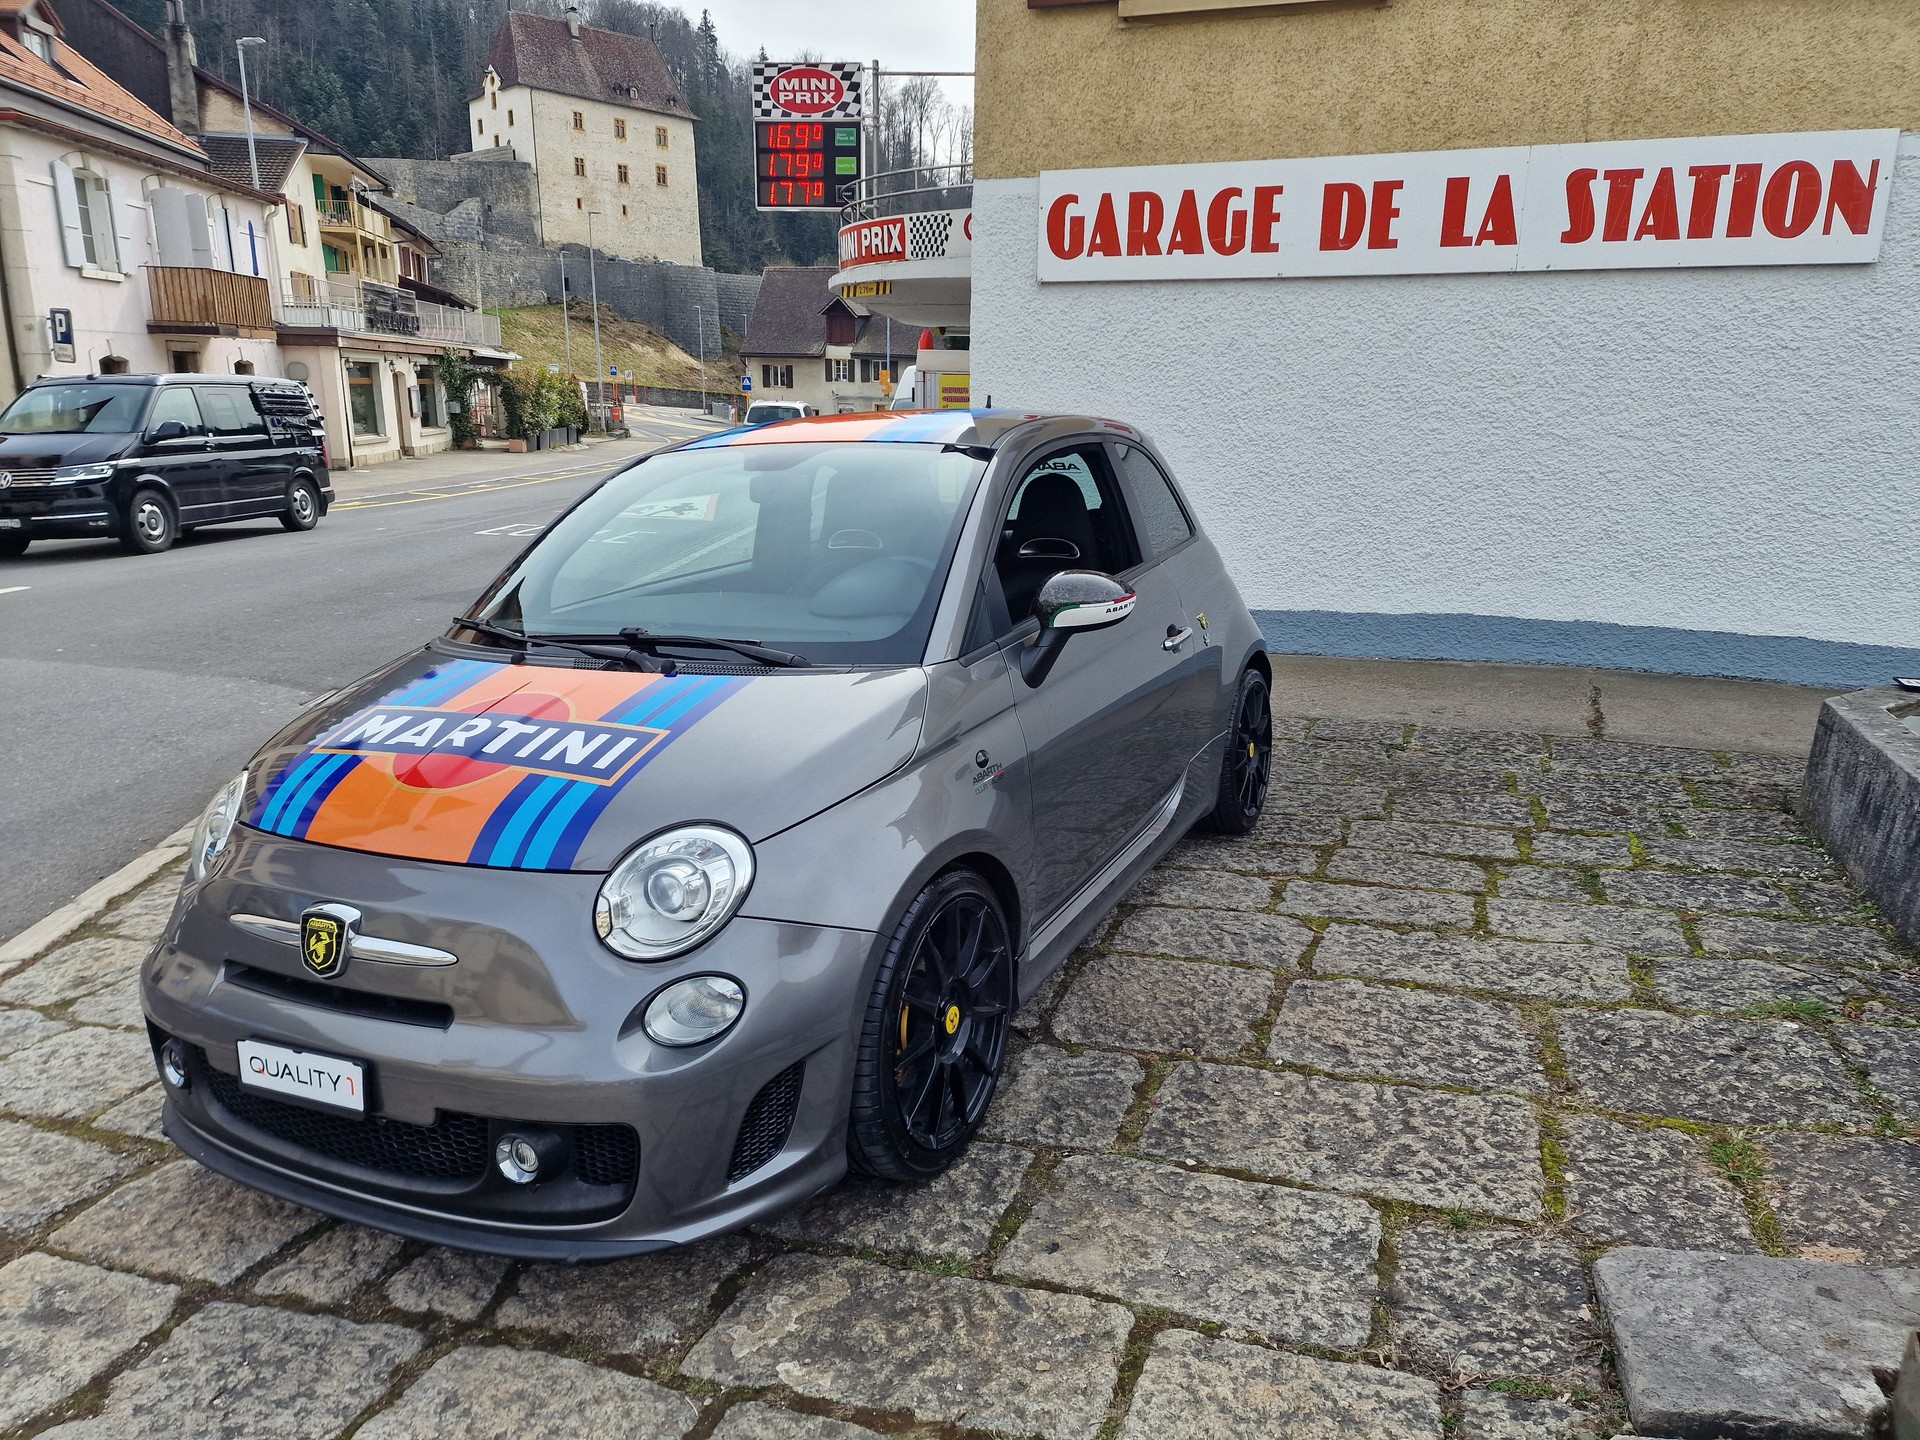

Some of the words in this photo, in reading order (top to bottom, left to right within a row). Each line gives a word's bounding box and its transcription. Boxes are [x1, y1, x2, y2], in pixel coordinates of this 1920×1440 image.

[778, 78, 836, 91] MINI
[778, 91, 836, 104] PRIX
[1046, 185, 1284, 261] GARAGE
[1319, 179, 1405, 252] DE
[1440, 174, 1518, 247] LA
[1560, 158, 1881, 244] STATION
[840, 230, 858, 262] MINI
[861, 223, 903, 257] PRIX
[55, 313, 66, 341] P
[340, 715, 638, 770] MARTINI
[972, 762, 1003, 785] ABARTH
[310, 921, 334, 930] ABARTH
[249, 1056, 341, 1092] QUALITY
